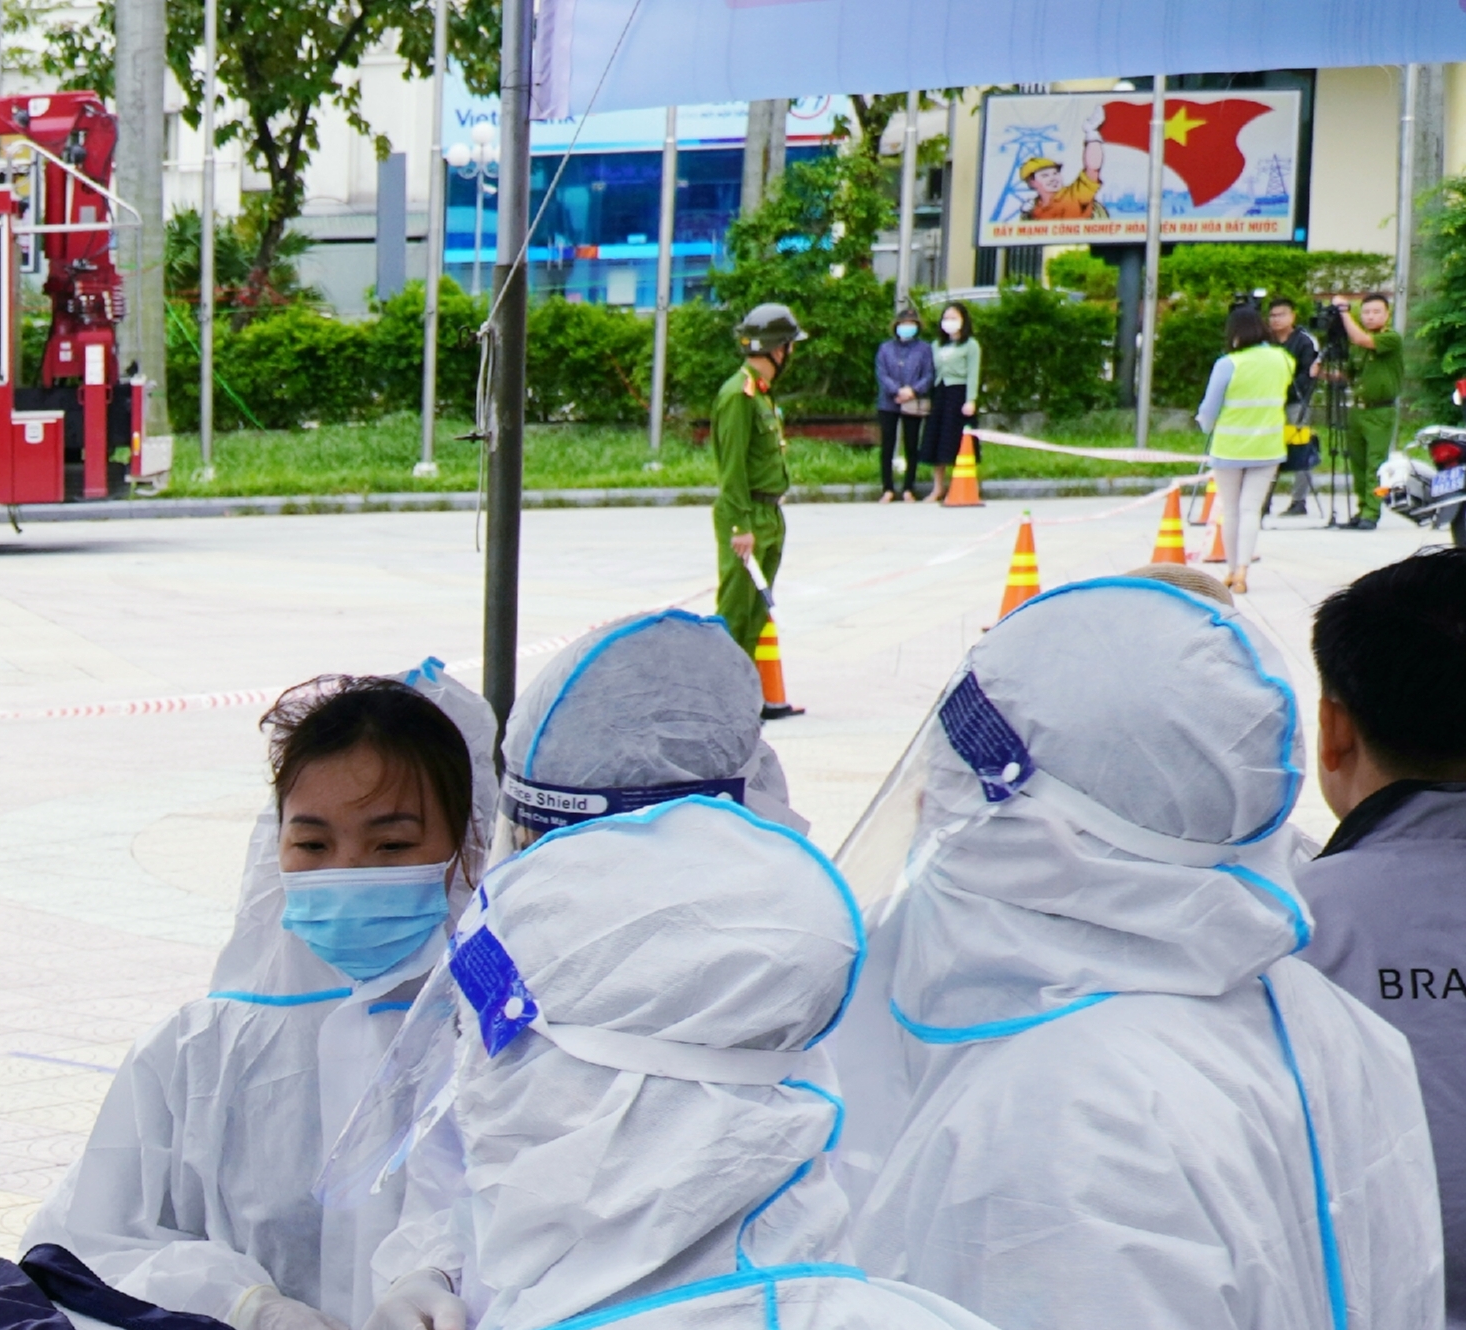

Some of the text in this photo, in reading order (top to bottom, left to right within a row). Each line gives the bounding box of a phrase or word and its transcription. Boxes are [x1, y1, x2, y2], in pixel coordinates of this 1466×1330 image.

[1052, 224, 1080, 236] CÔNG
[536, 792, 587, 811] Shield
[1378, 968, 1466, 1000] BRA
